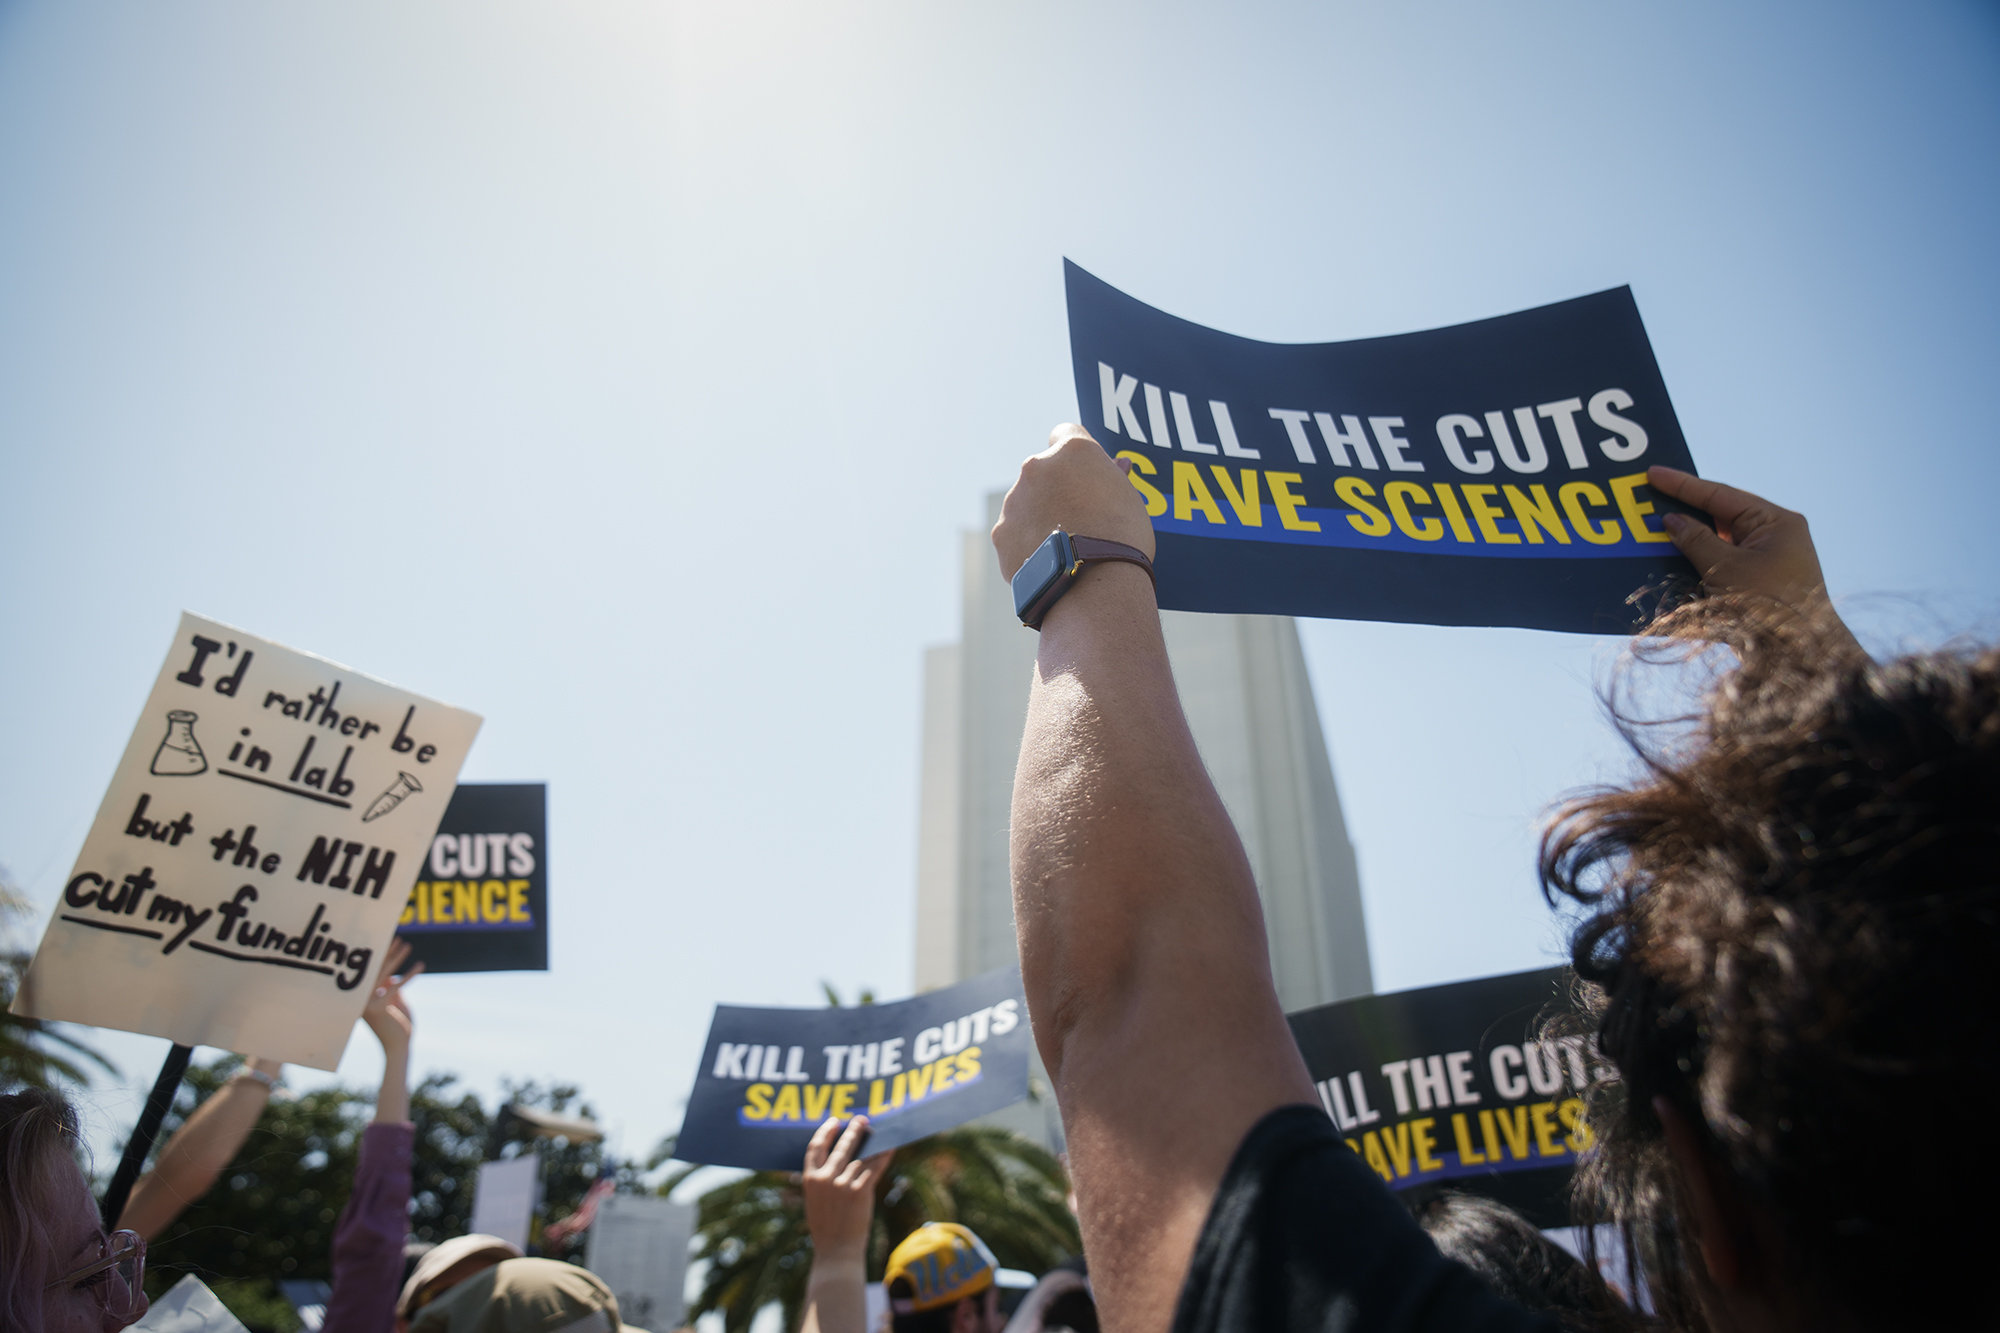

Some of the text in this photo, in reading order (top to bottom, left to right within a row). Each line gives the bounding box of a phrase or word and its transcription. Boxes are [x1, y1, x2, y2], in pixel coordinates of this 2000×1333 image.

[1098, 361, 1649, 475] KILL THE CUTS
[1115, 450, 1673, 545] SAVE SCIENCE
[176, 634, 438, 763] I'd rather be
[228, 727, 355, 796] in lab
[125, 793, 396, 899] but the NIH
[430, 833, 535, 878] CUTS
[65, 866, 372, 990] cut my funding
[712, 998, 1019, 1082] KILL THE CUTS
[742, 1046, 983, 1121] SAVE LIVES
[1315, 1071, 1380, 1131] ILL
[1381, 1050, 1482, 1114] THE
[1451, 1097, 1594, 1166] LIVES
